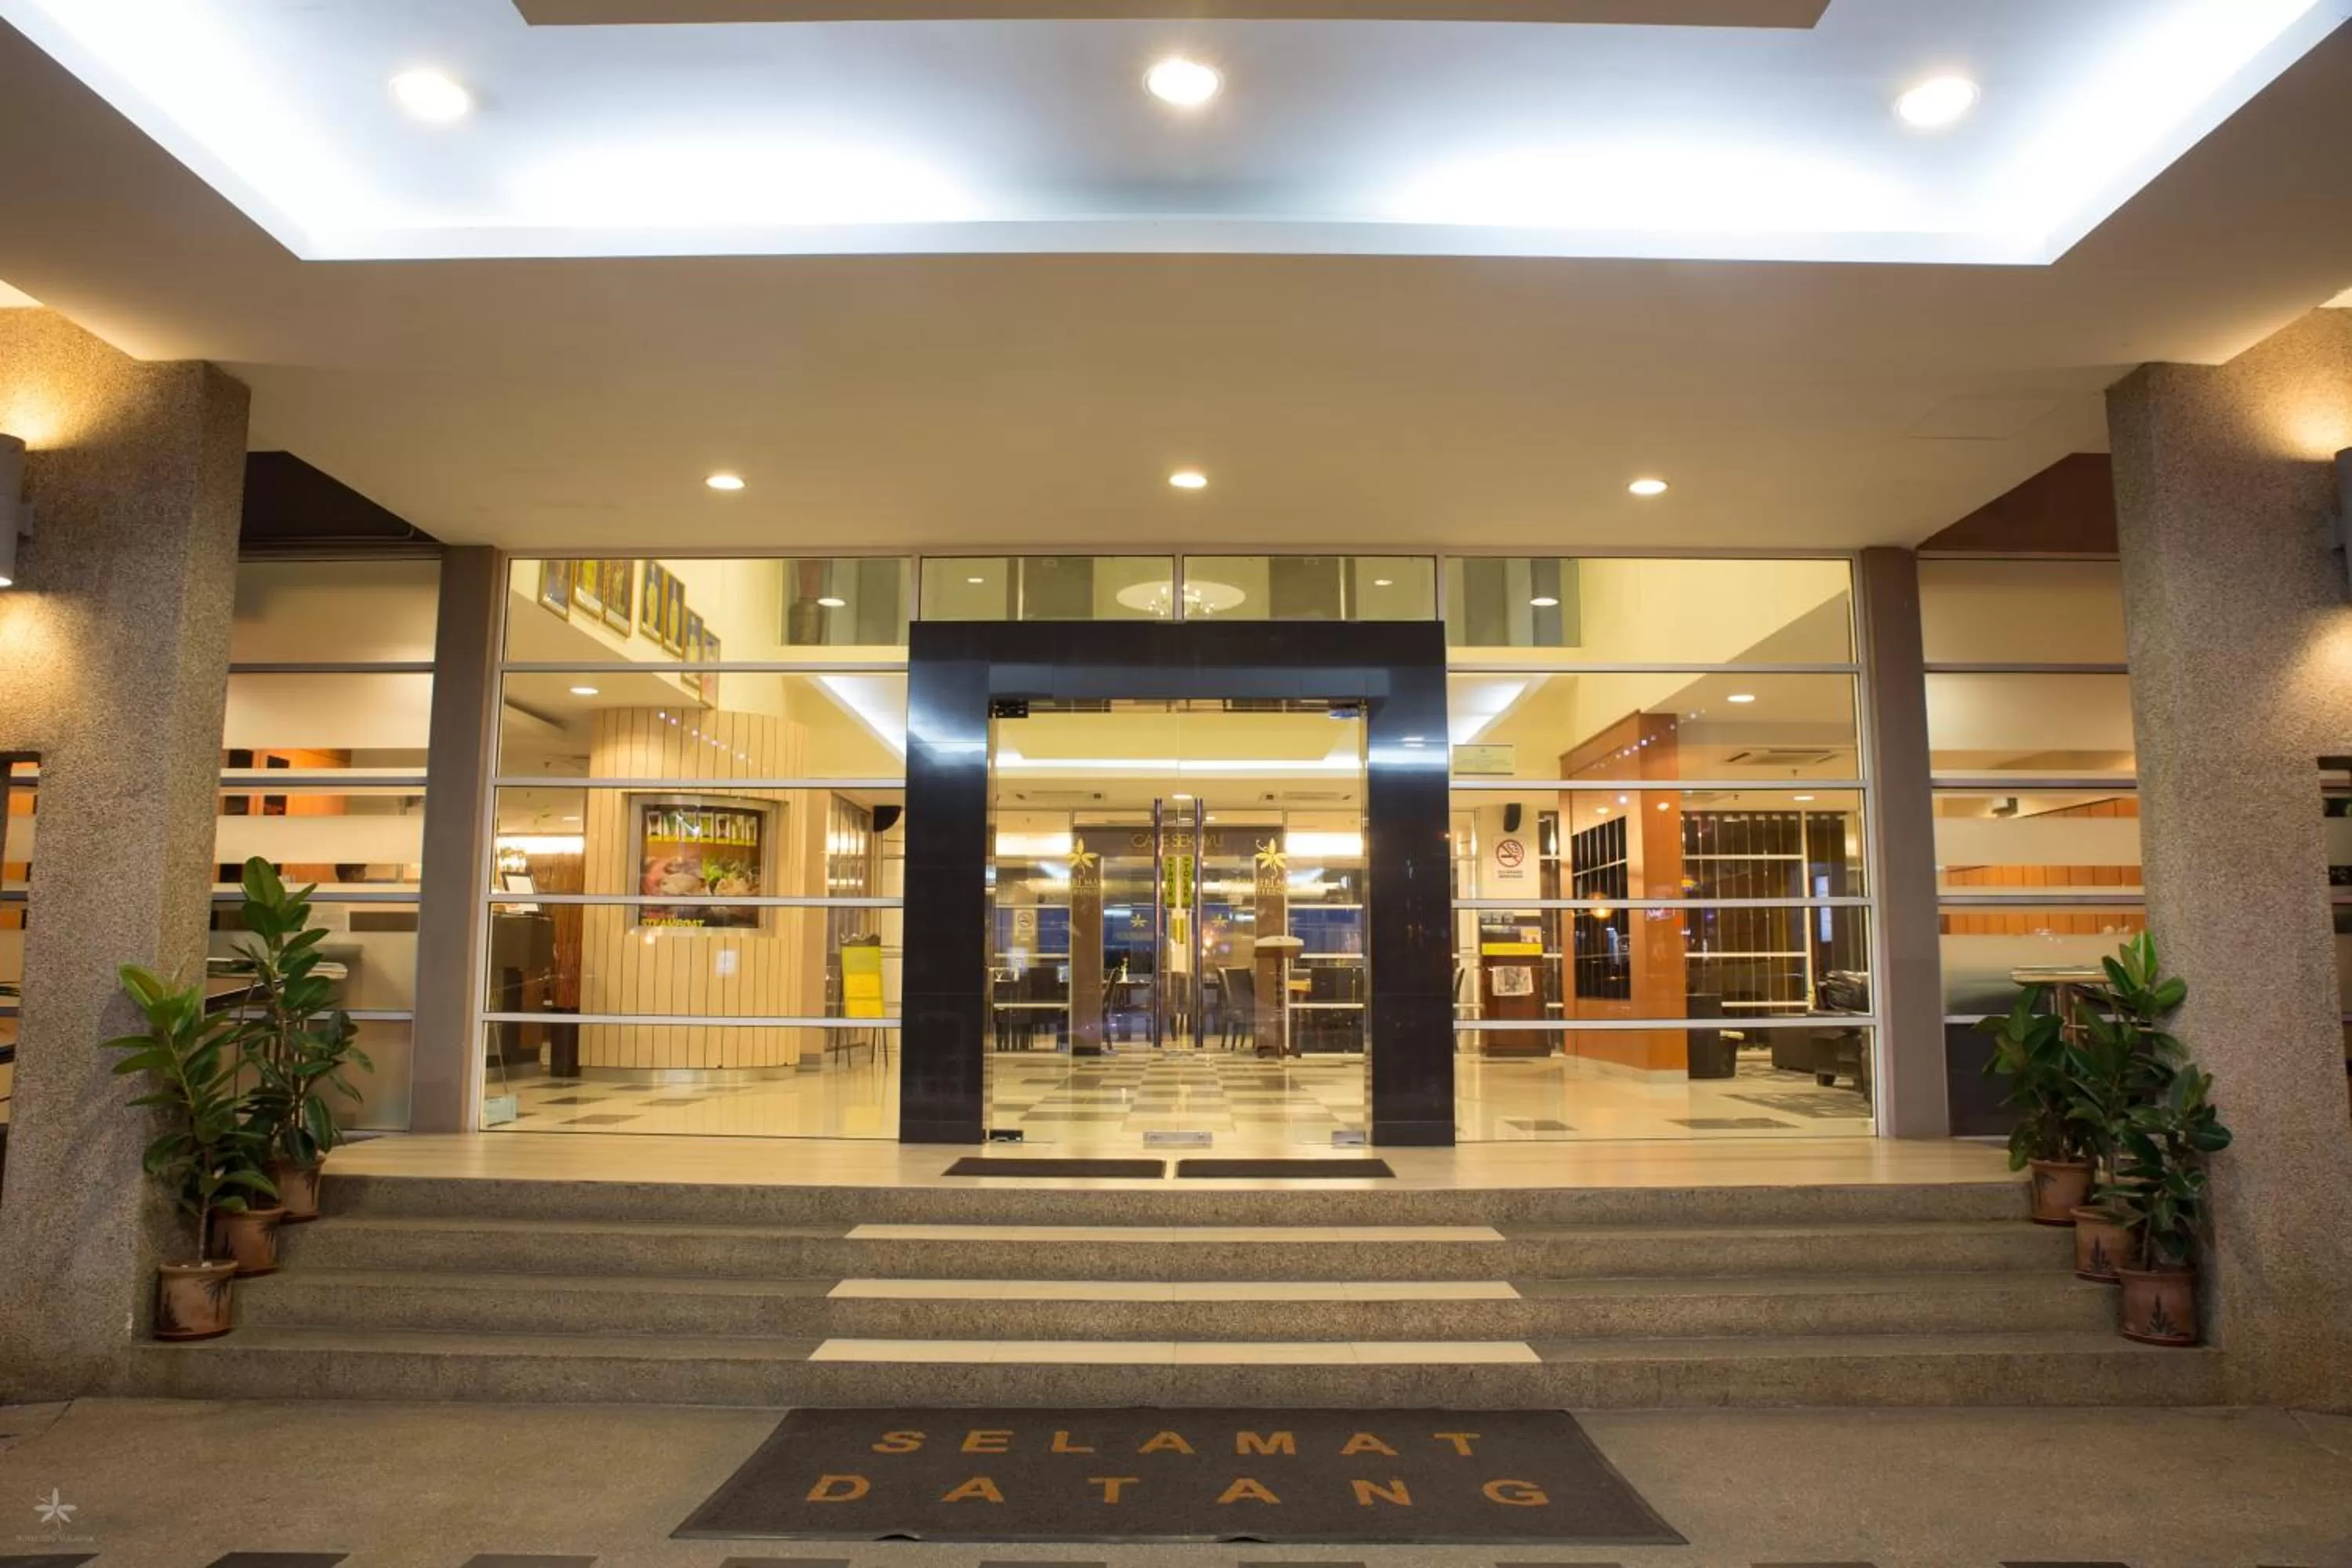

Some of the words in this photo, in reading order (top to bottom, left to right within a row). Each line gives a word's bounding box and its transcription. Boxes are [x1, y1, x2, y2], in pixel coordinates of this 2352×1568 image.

[1131, 833, 1171, 848] CAE
[872, 1429, 1481, 1457] SELAMAT
[805, 1474, 1550, 1506] DATANG
